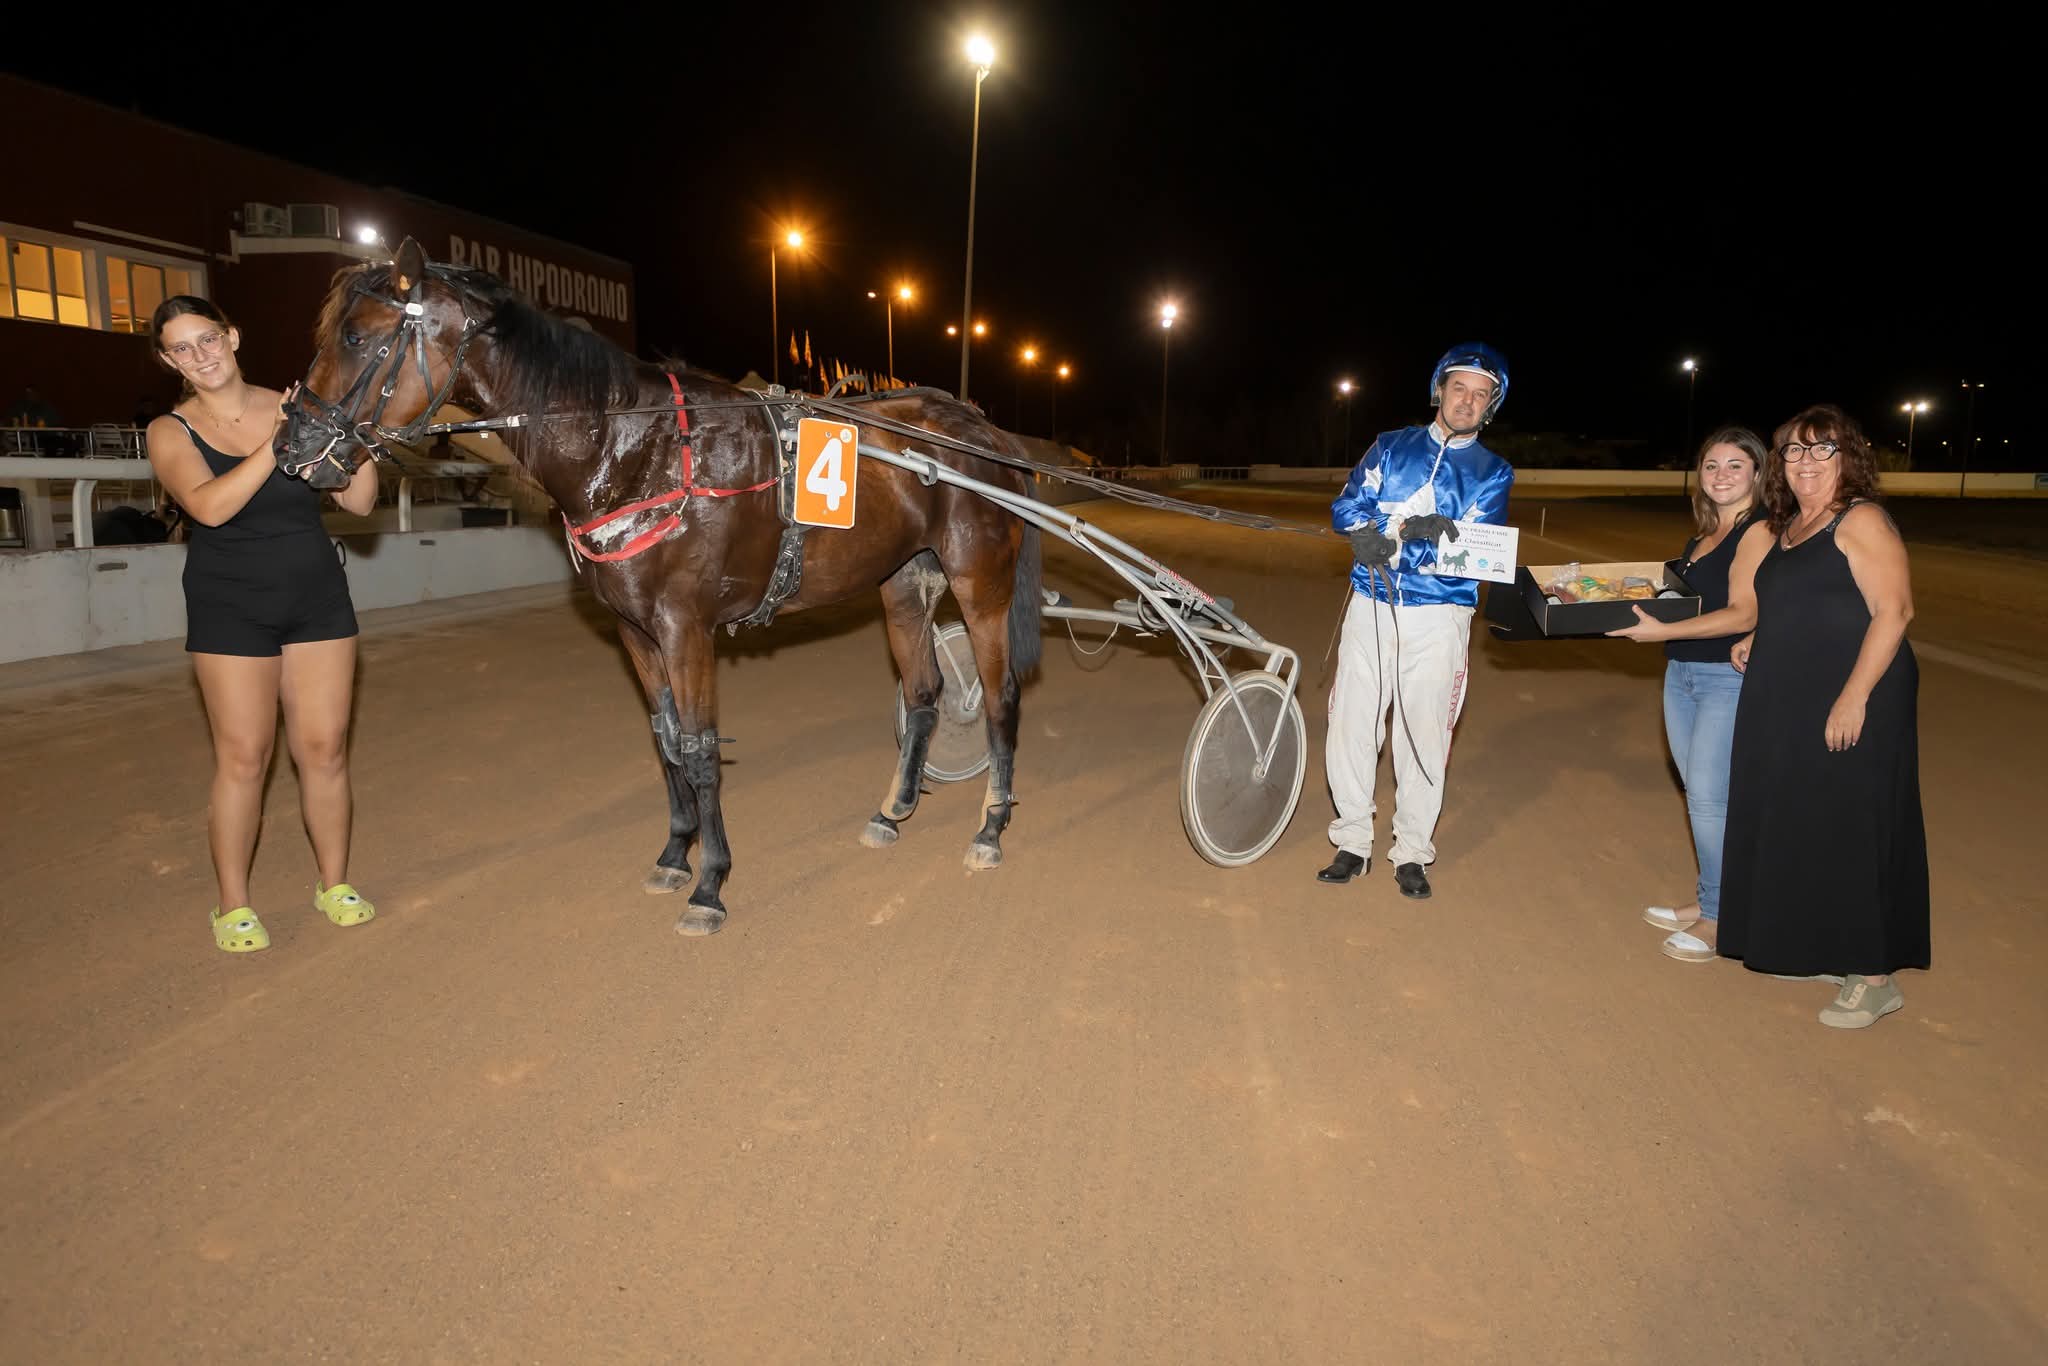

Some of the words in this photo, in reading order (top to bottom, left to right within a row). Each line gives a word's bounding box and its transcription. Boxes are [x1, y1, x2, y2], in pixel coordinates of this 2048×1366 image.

[449, 234, 502, 275] BAR
[508, 251, 628, 322] HIPODROMO
[806, 437, 847, 511] 4
